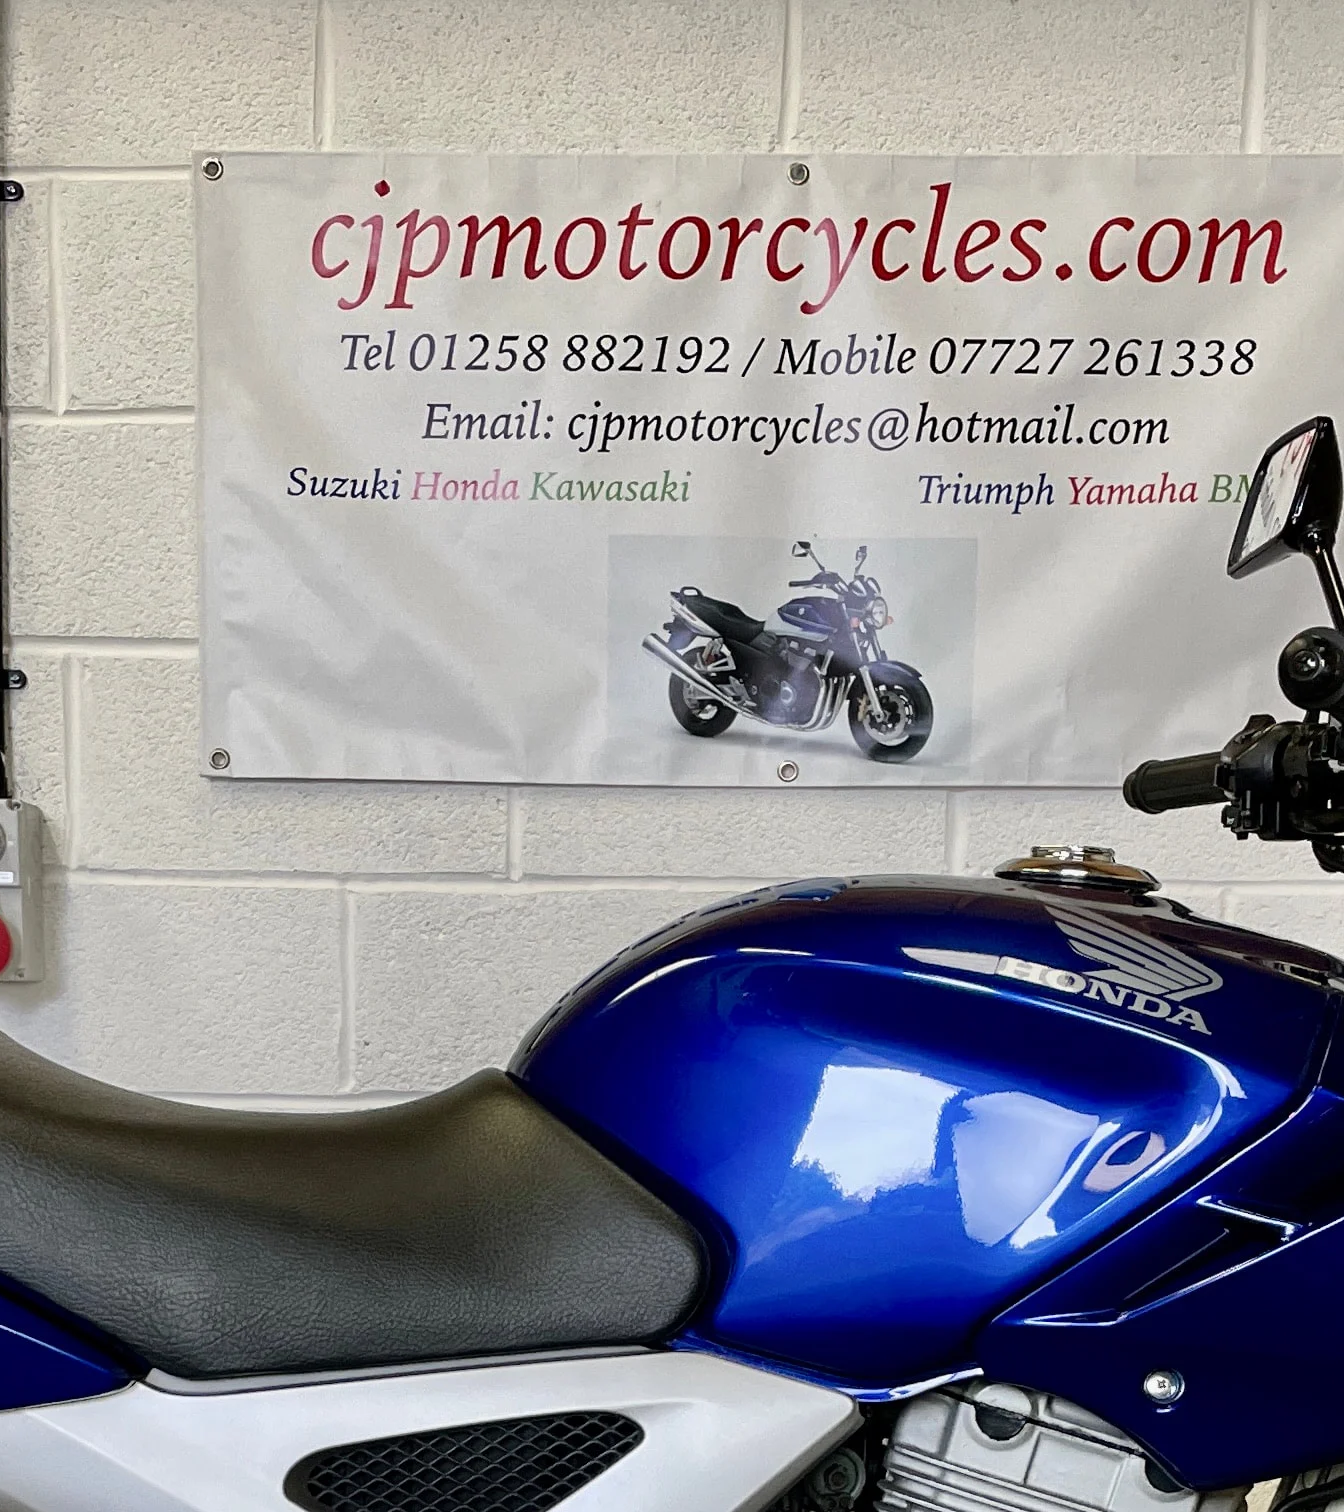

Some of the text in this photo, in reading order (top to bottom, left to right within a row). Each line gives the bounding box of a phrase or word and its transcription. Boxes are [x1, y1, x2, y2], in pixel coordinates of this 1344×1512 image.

[311, 180, 1288, 315] cjpmotorcycles.com
[341, 332, 1257, 378] Tel 01258 882192 / Mobile 07727 261338
[421, 399, 1170, 456] Email: cjpmotorcycles@hotmail.com
[287, 467, 691, 503] Suzuki Honda Kawasaki
[918, 472, 1254, 515] Triumph Yamaha BM
[997, 956, 1212, 1035] HONDA
